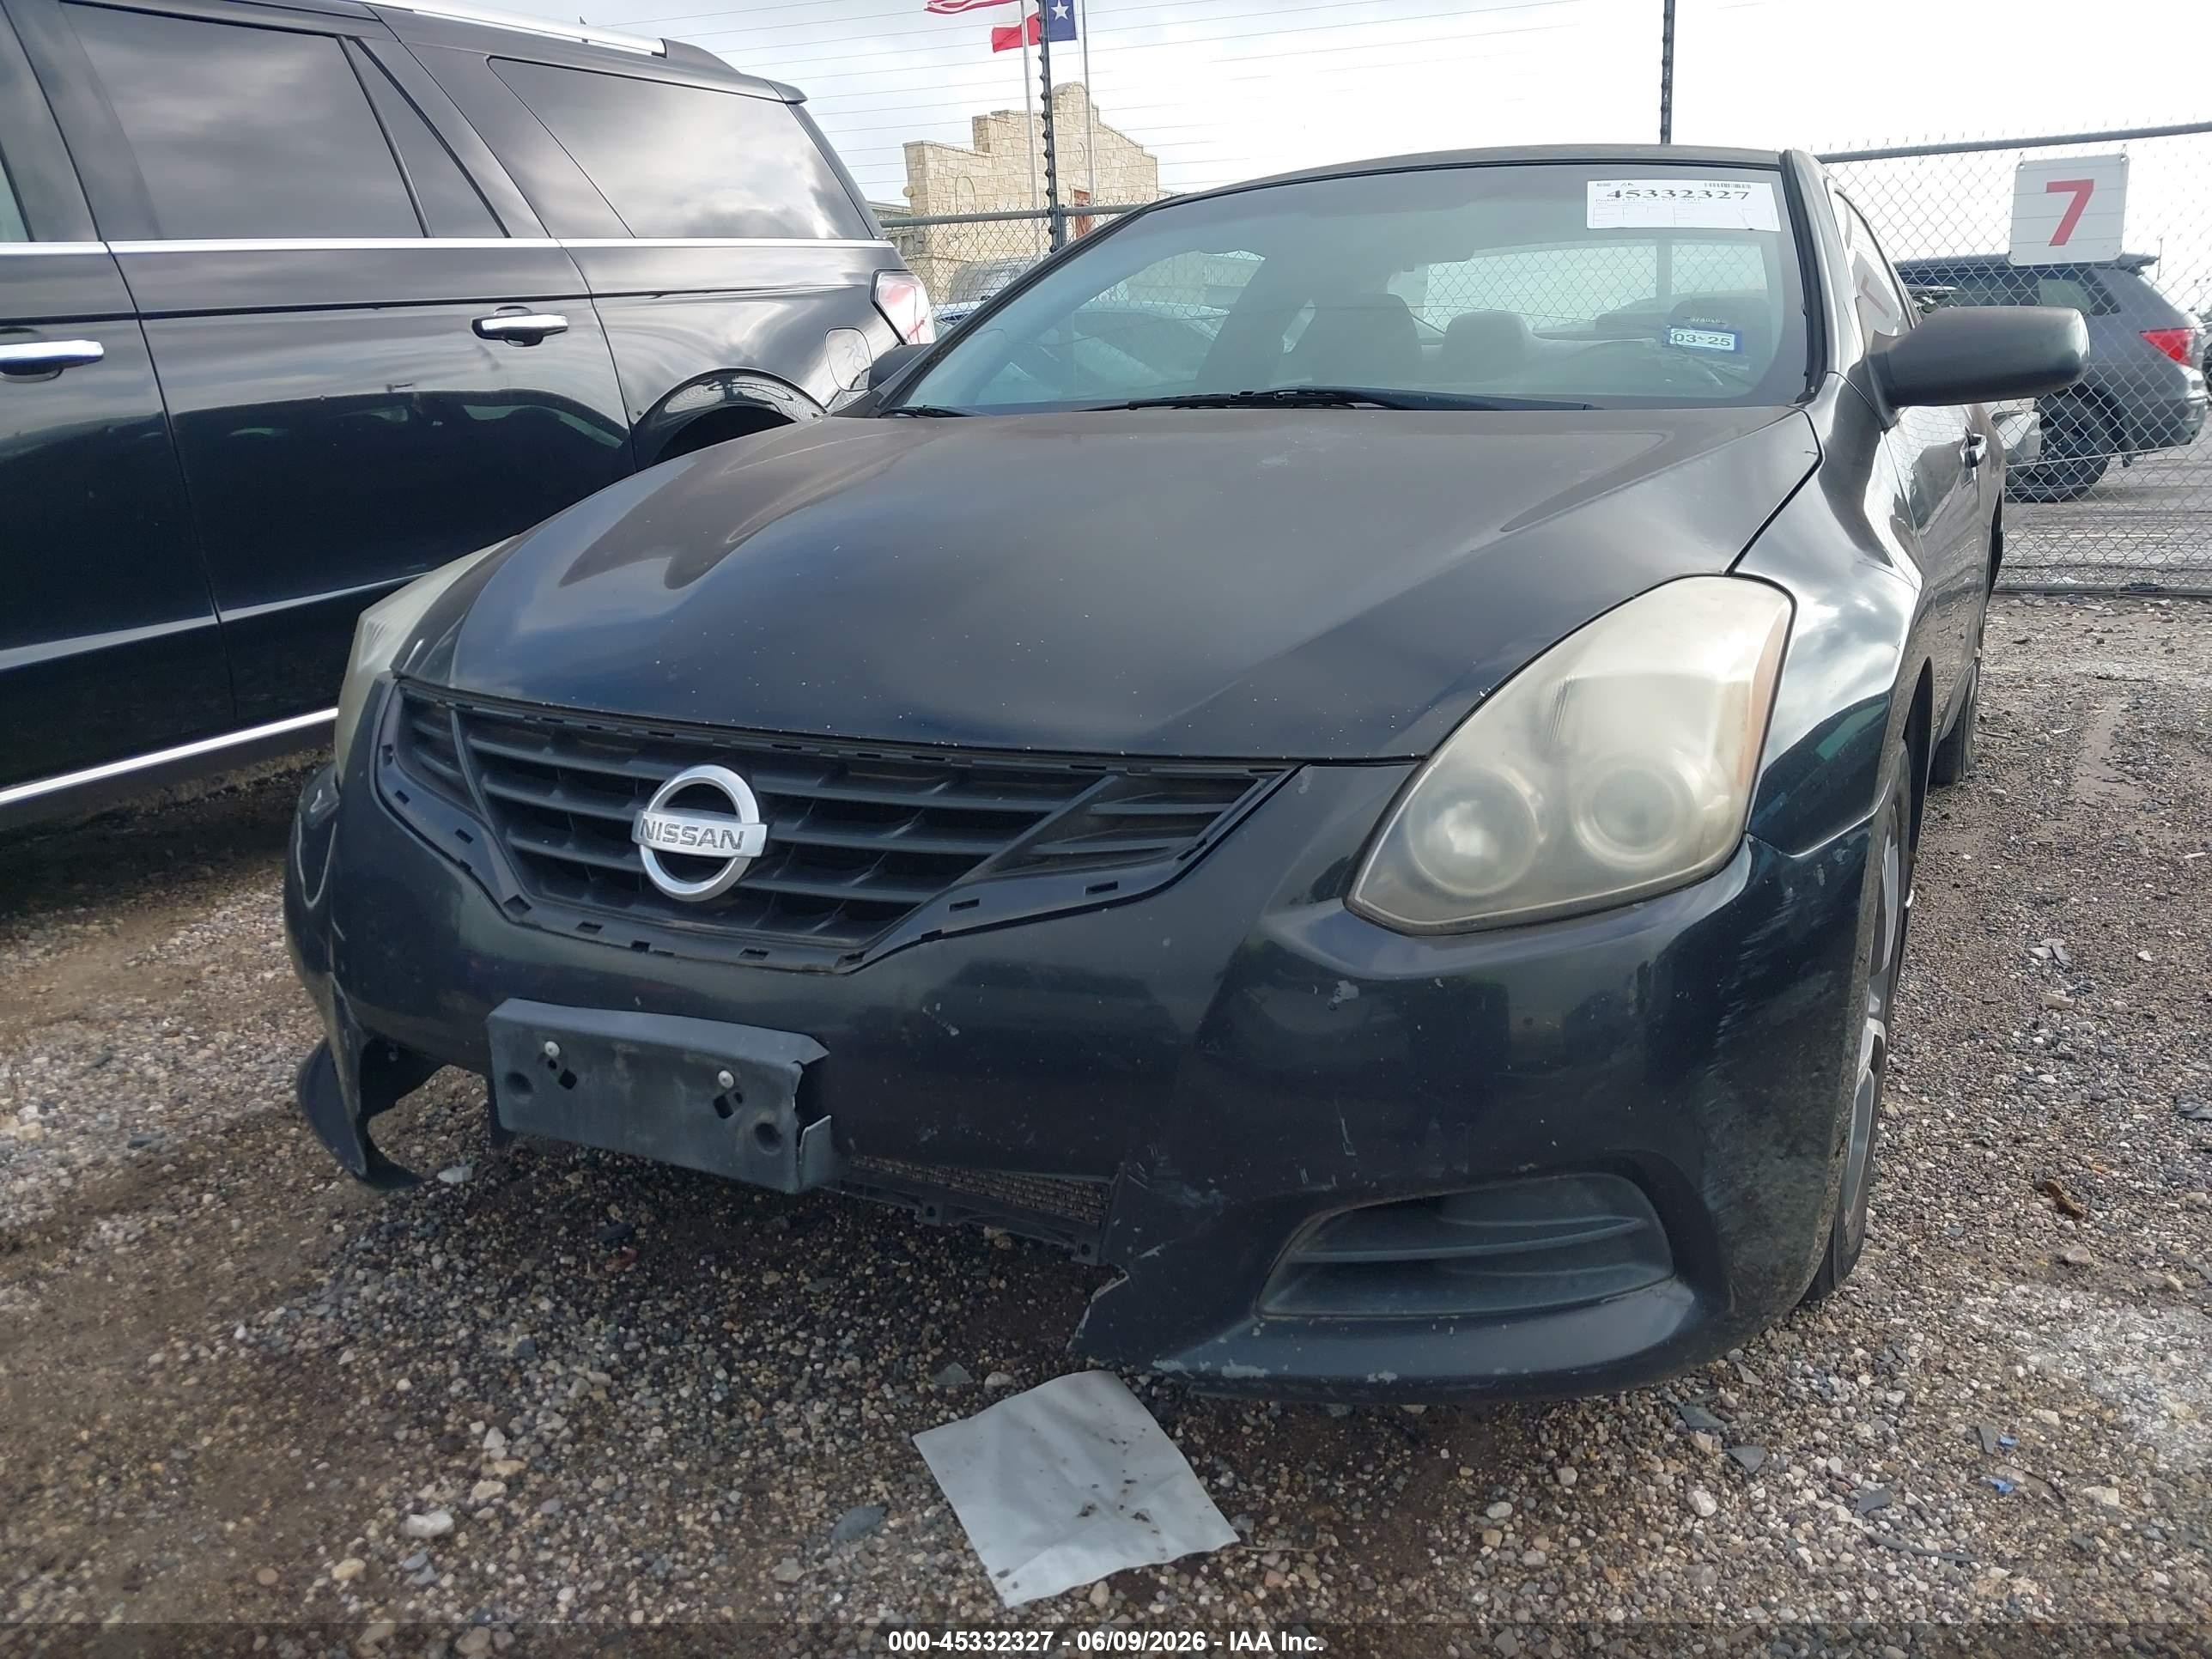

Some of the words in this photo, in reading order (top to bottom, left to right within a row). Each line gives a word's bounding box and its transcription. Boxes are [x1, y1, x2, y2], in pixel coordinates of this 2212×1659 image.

[1606, 189, 1750, 200] 45332327
[2045, 179, 2095, 246] 7
[640, 817, 744, 850] NISSAN
